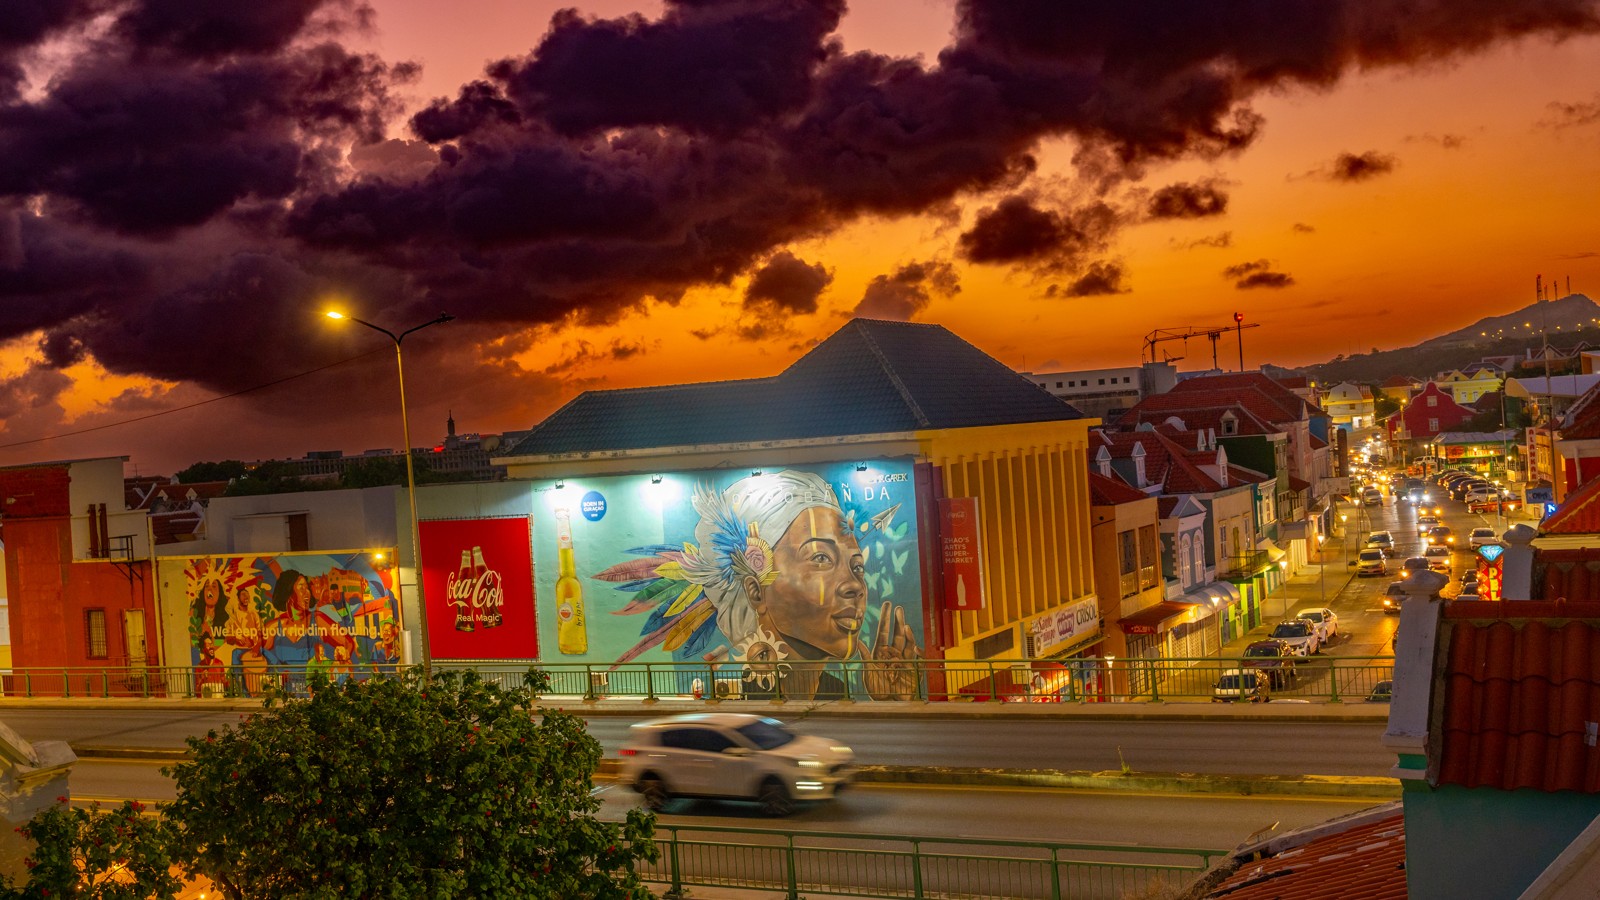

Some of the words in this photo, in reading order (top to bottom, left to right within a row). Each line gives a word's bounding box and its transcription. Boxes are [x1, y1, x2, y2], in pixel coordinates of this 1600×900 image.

[446, 569, 504, 608] Coca-Cola
[457, 614, 474, 622] Real
[475, 614, 500, 623] Magic
[1076, 604, 1097, 626] CRISOL
[210, 625, 228, 637] We
[262, 626, 287, 640] your
